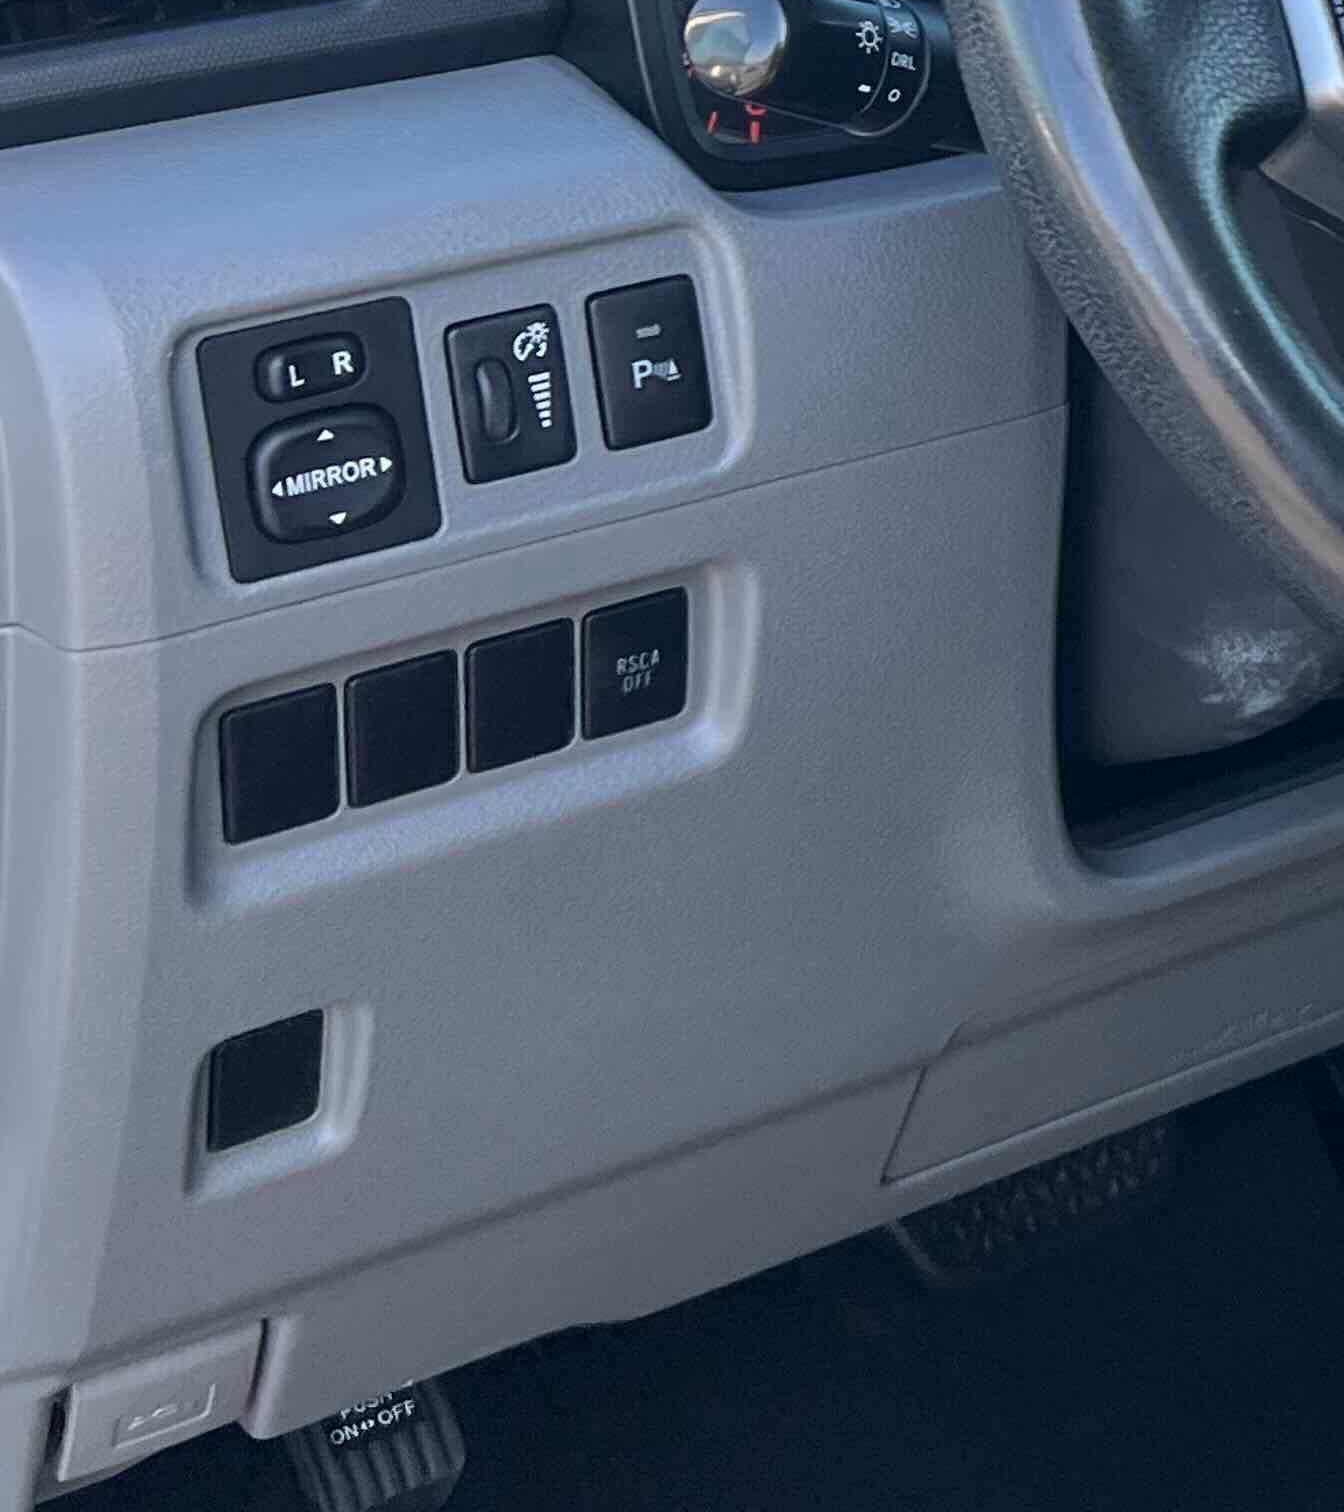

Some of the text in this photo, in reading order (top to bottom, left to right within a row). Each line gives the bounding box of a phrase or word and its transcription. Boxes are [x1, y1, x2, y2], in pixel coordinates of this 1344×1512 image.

[890, 51, 916, 72] DRL
[288, 350, 355, 388] L R
[285, 456, 379, 497] MIRROR
[616, 648, 661, 676] RSCA
[330, 1399, 417, 1445] ON OFF
